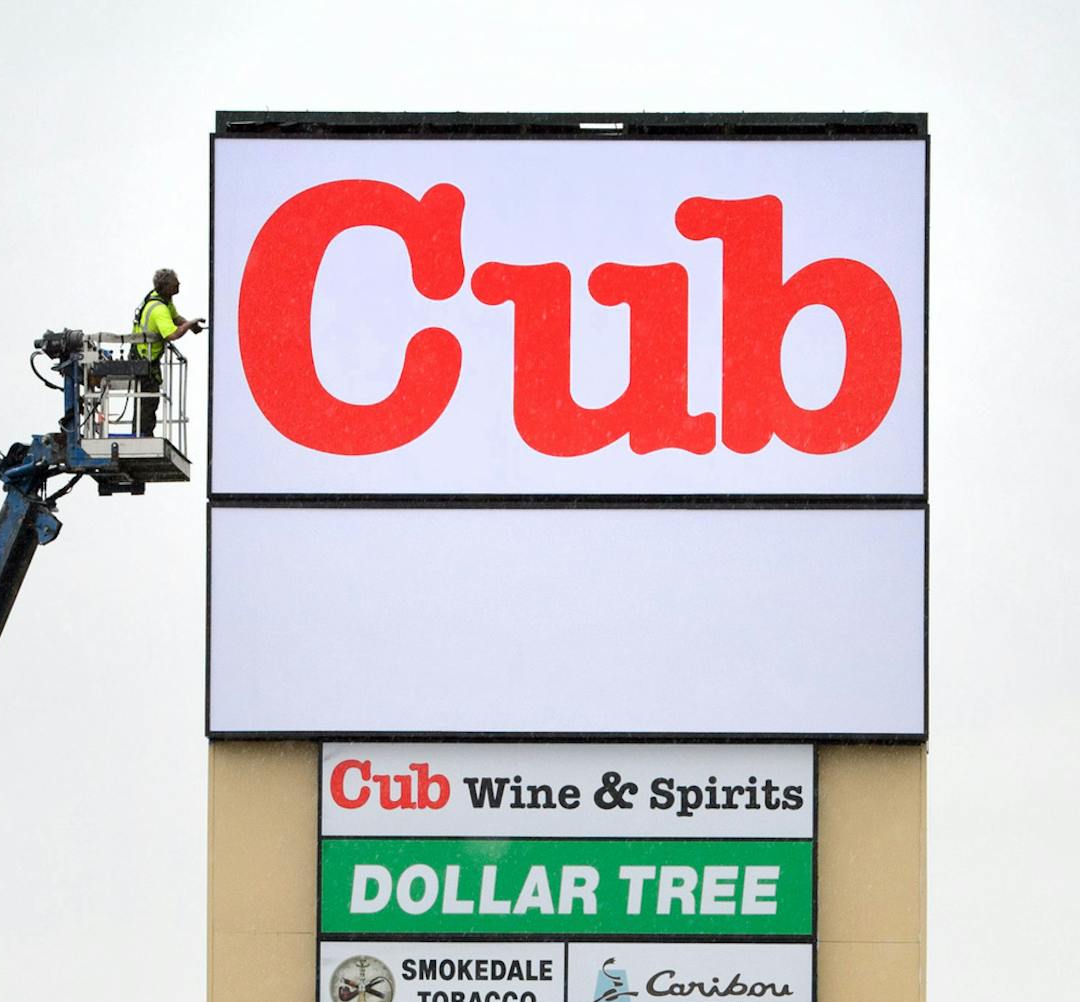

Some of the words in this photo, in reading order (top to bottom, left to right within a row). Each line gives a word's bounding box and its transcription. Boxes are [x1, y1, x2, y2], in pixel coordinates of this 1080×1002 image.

[237, 178, 903, 458] Cub
[330, 759, 451, 810] Cub
[463, 777, 581, 810] Wine
[593, 771, 638, 810] &
[650, 775, 804, 817] Spirits
[349, 863, 600, 915] DOLLAR
[618, 865, 780, 915] TREE
[401, 958, 553, 982] SMOKEDALE
[646, 970, 794, 997] Caribou
